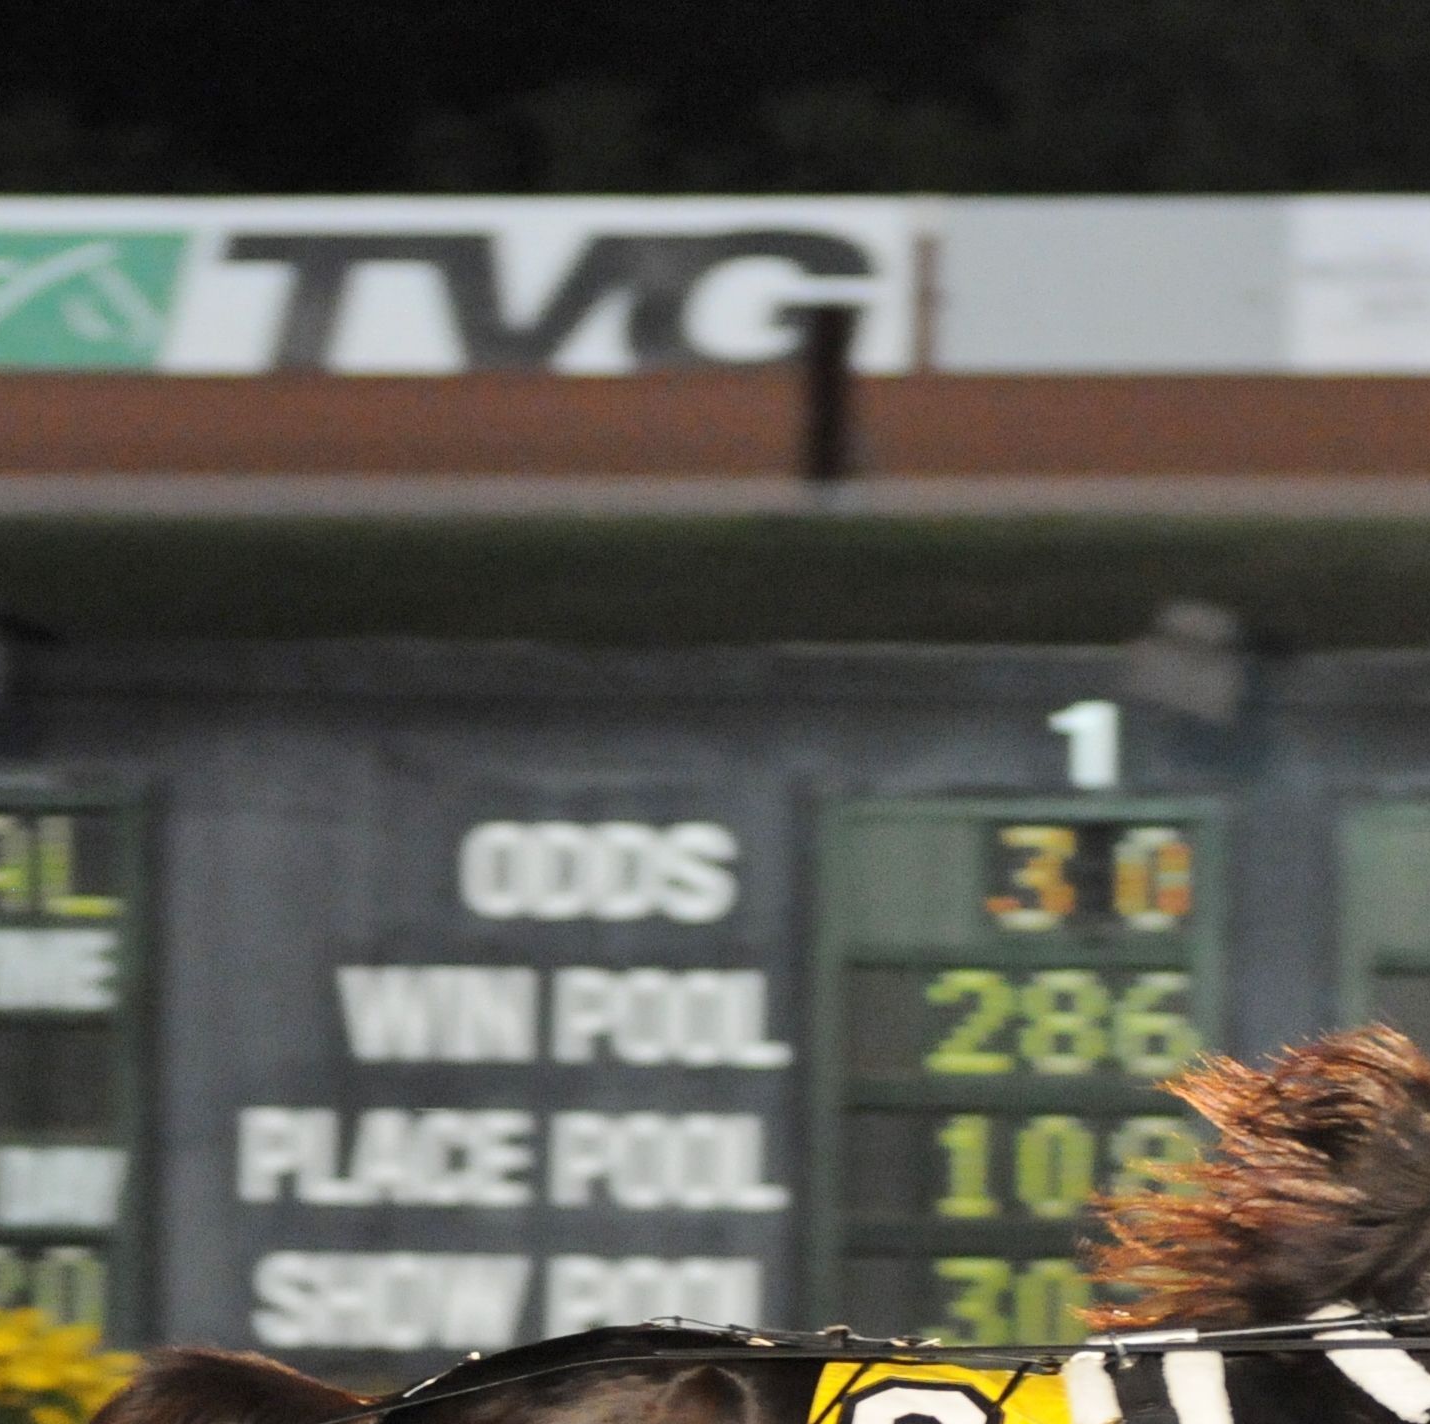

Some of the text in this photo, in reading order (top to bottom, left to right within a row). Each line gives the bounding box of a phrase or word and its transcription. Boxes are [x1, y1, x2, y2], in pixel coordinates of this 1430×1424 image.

[219, 228, 877, 370] TVG
[1047, 700, 1120, 790] 1
[459, 820, 740, 924] ODDS
[336, 962, 794, 1069] WIN POOL
[921, 967, 1205, 1078] 286
[236, 1105, 792, 1213] PLACE POOL
[251, 1250, 533, 1351] SHOW
